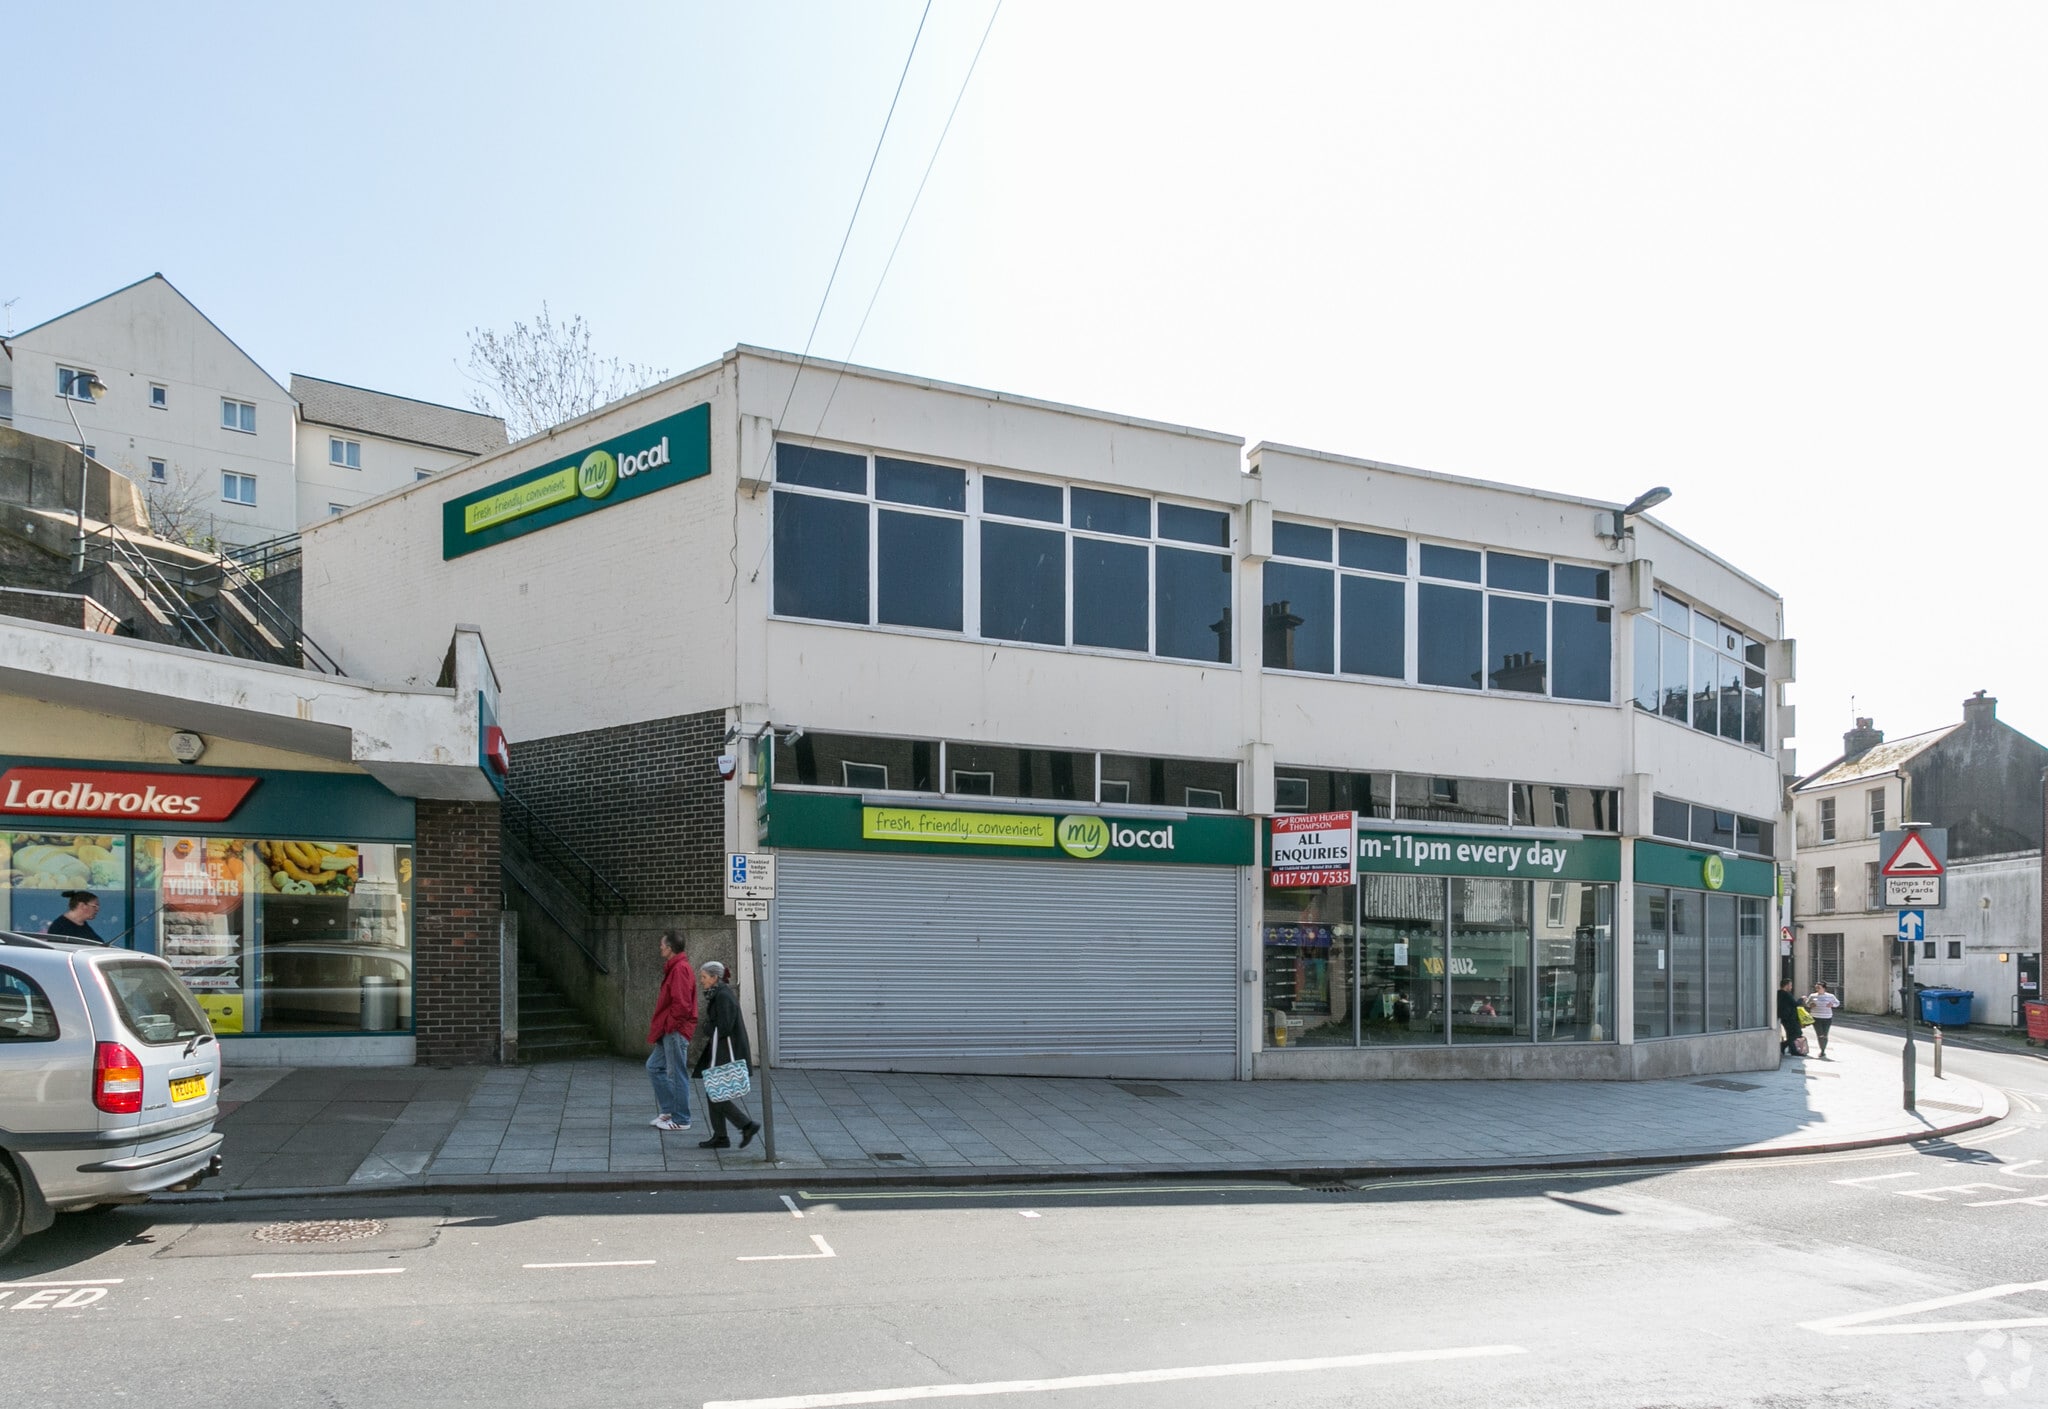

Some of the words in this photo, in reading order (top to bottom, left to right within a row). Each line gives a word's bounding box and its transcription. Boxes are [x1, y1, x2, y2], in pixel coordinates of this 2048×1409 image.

[584, 460, 607, 490] my
[617, 436, 670, 479] local
[5, 779, 201, 815] Ladbrokes
[876, 811, 915, 832] fresh,
[919, 813, 973, 840] friendly,
[976, 821, 1044, 837] convenient
[1288, 815, 1318, 825] ROWLEY
[1319, 812, 1349, 822] HUGHES
[1288, 821, 1332, 832] THOMPSON
[1067, 823, 1100, 852] my
[1111, 822, 1175, 849] local
[1298, 833, 1322, 845] ALL
[736, 856, 745, 868] P
[1274, 846, 1348, 863] ENQUIRIES
[1456, 844, 1522, 872] every
[1526, 841, 1567, 873] day
[184, 862, 223, 879] PLACE
[1272, 872, 1297, 885] 0117
[1299, 871, 1320, 884] 970
[1322, 871, 1349, 884] 7535
[168, 879, 204, 896] YOUR
[207, 880, 239, 896] BETS
